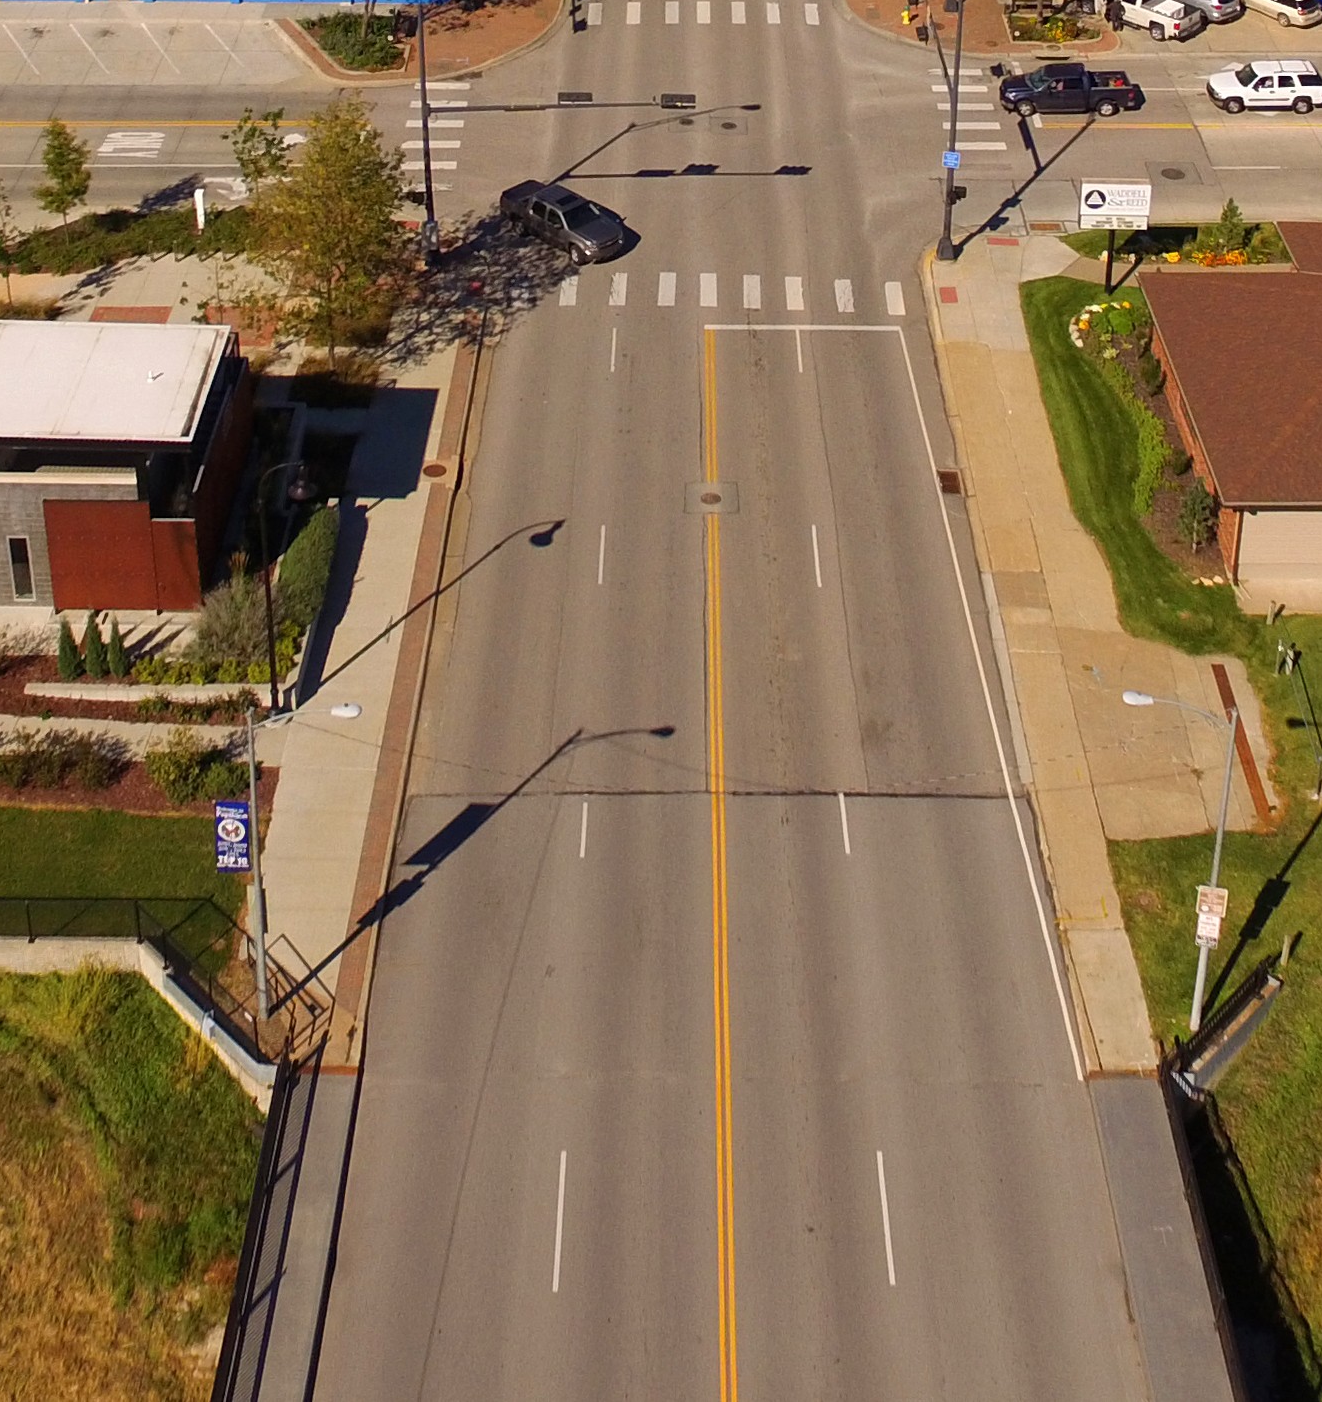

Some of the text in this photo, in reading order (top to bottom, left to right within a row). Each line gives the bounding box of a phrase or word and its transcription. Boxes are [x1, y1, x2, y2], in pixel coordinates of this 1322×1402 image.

[97, 131, 166, 158] ONLY
[1106, 189, 1147, 198] WADDELL
[1125, 198, 1148, 207] REED
